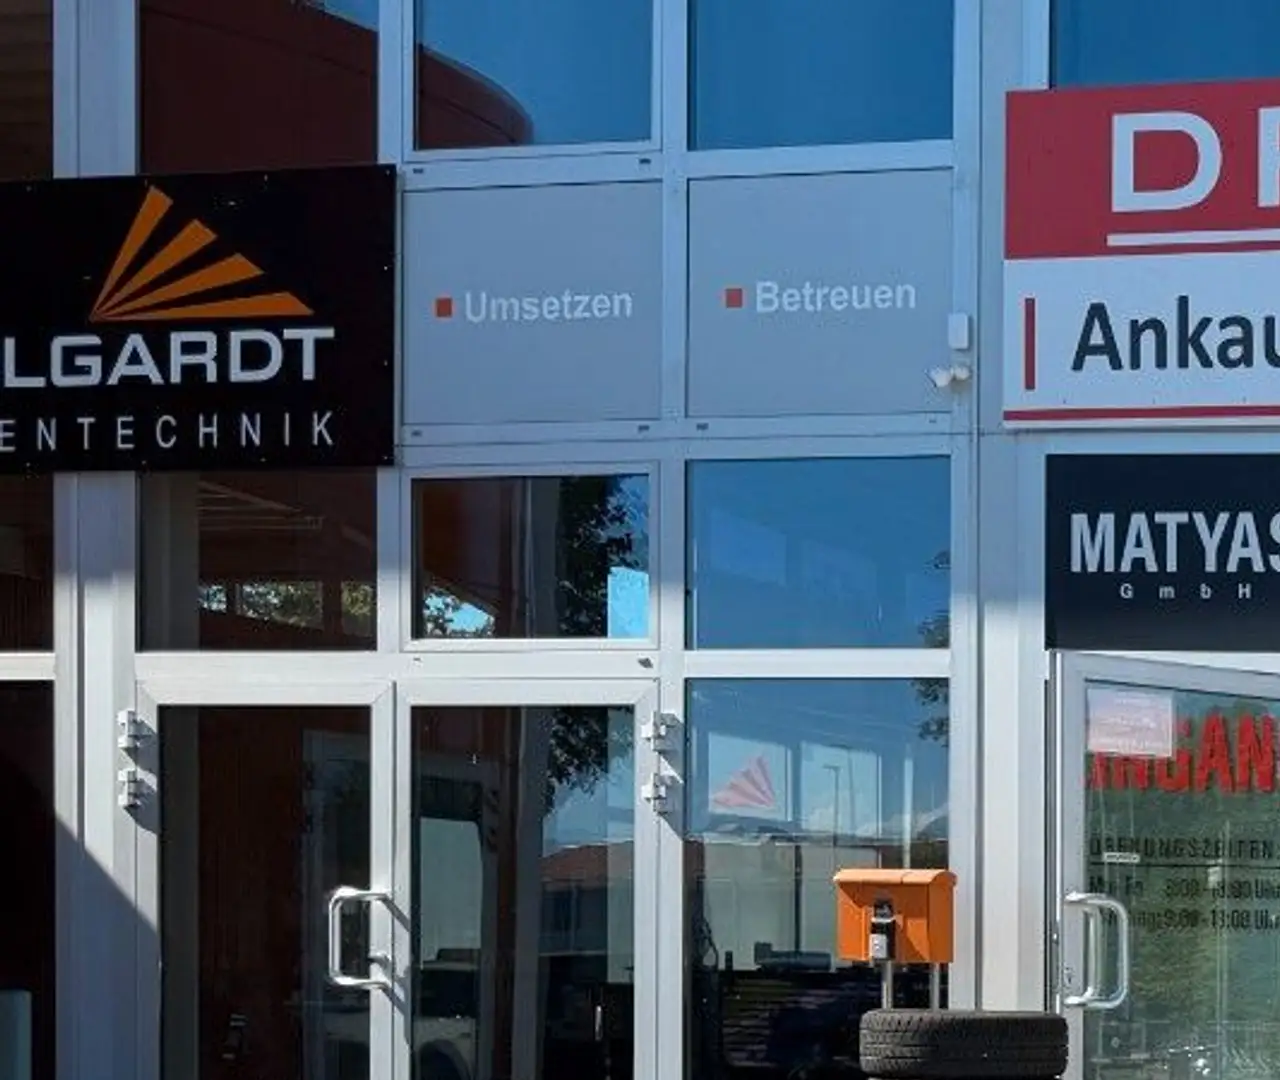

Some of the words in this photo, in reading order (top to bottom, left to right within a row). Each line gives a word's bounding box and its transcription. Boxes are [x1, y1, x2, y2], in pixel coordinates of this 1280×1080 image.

[464, 289, 634, 324] Umsetzen
[755, 281, 917, 314] Betreuen
[3, 328, 335, 388] LGARDT
